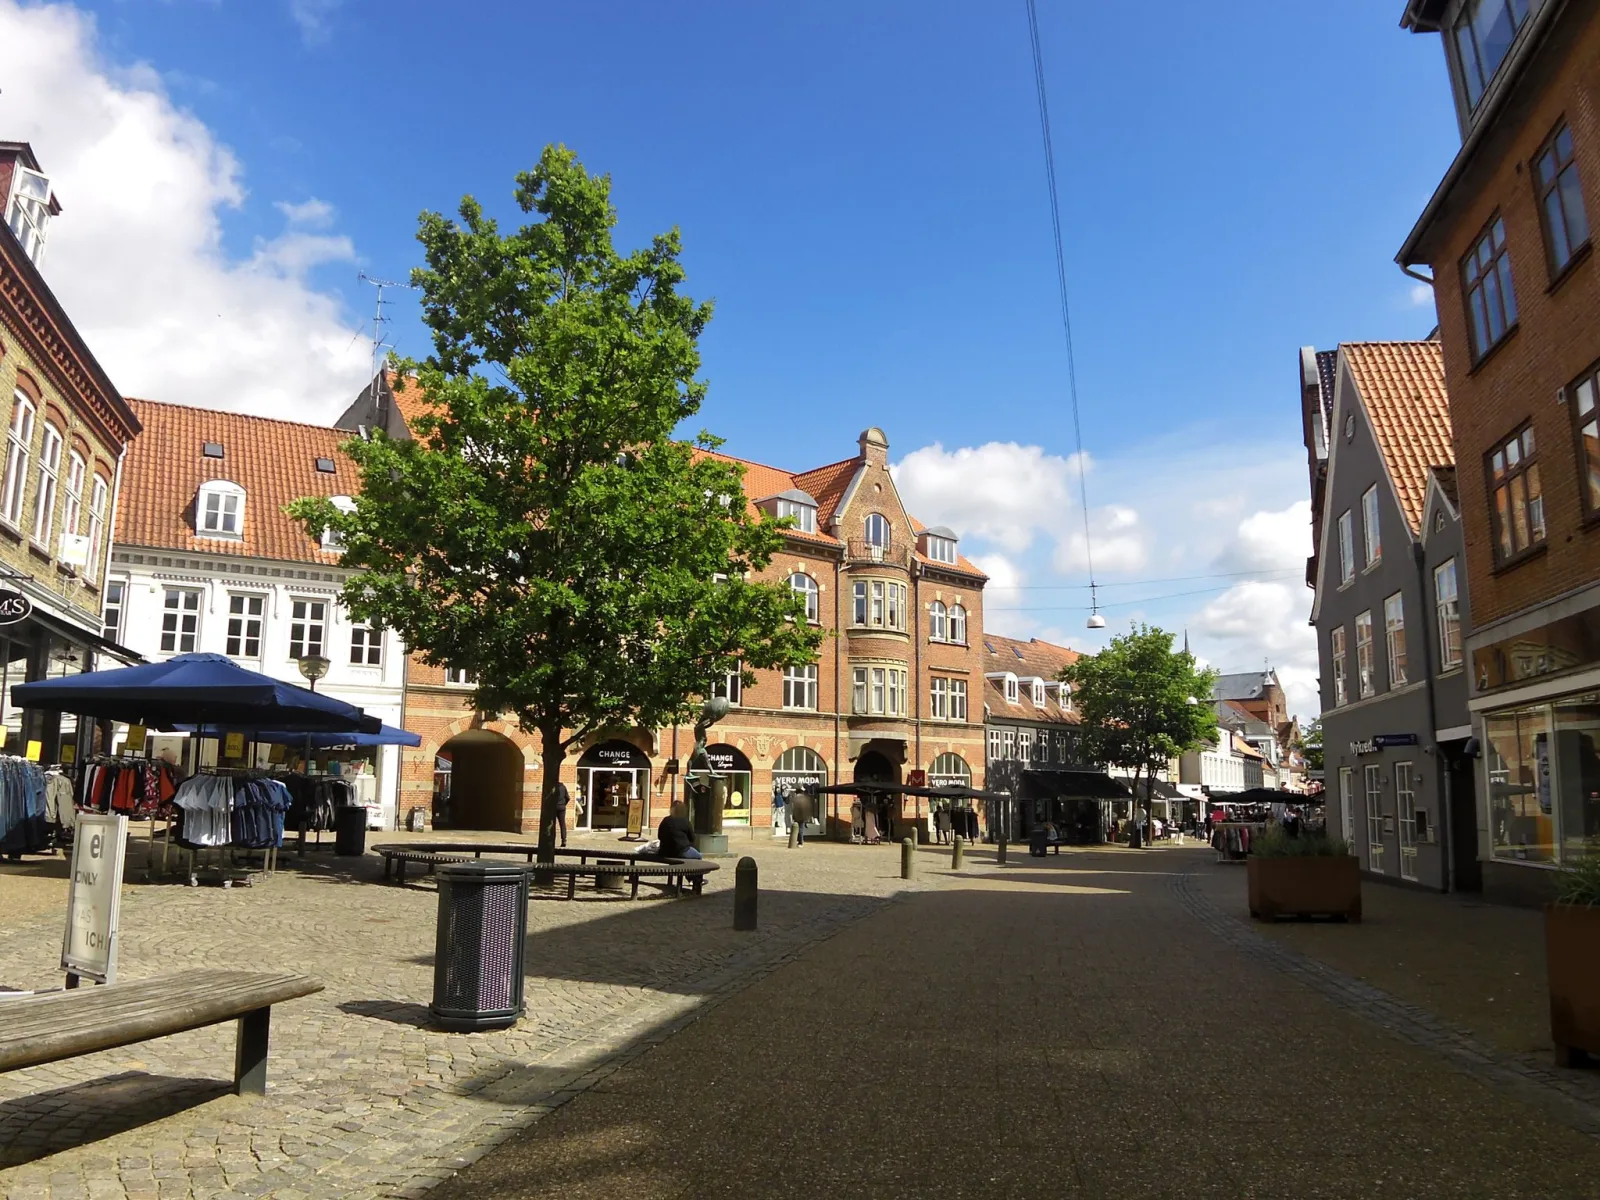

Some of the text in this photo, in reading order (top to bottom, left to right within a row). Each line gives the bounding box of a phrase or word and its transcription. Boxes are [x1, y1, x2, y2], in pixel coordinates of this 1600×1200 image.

[598, 750, 631, 759] CHANGE
[776, 776, 820, 785] VERO MODA
[931, 779, 948, 787] VERO
[75, 870, 98, 886] ONLY
